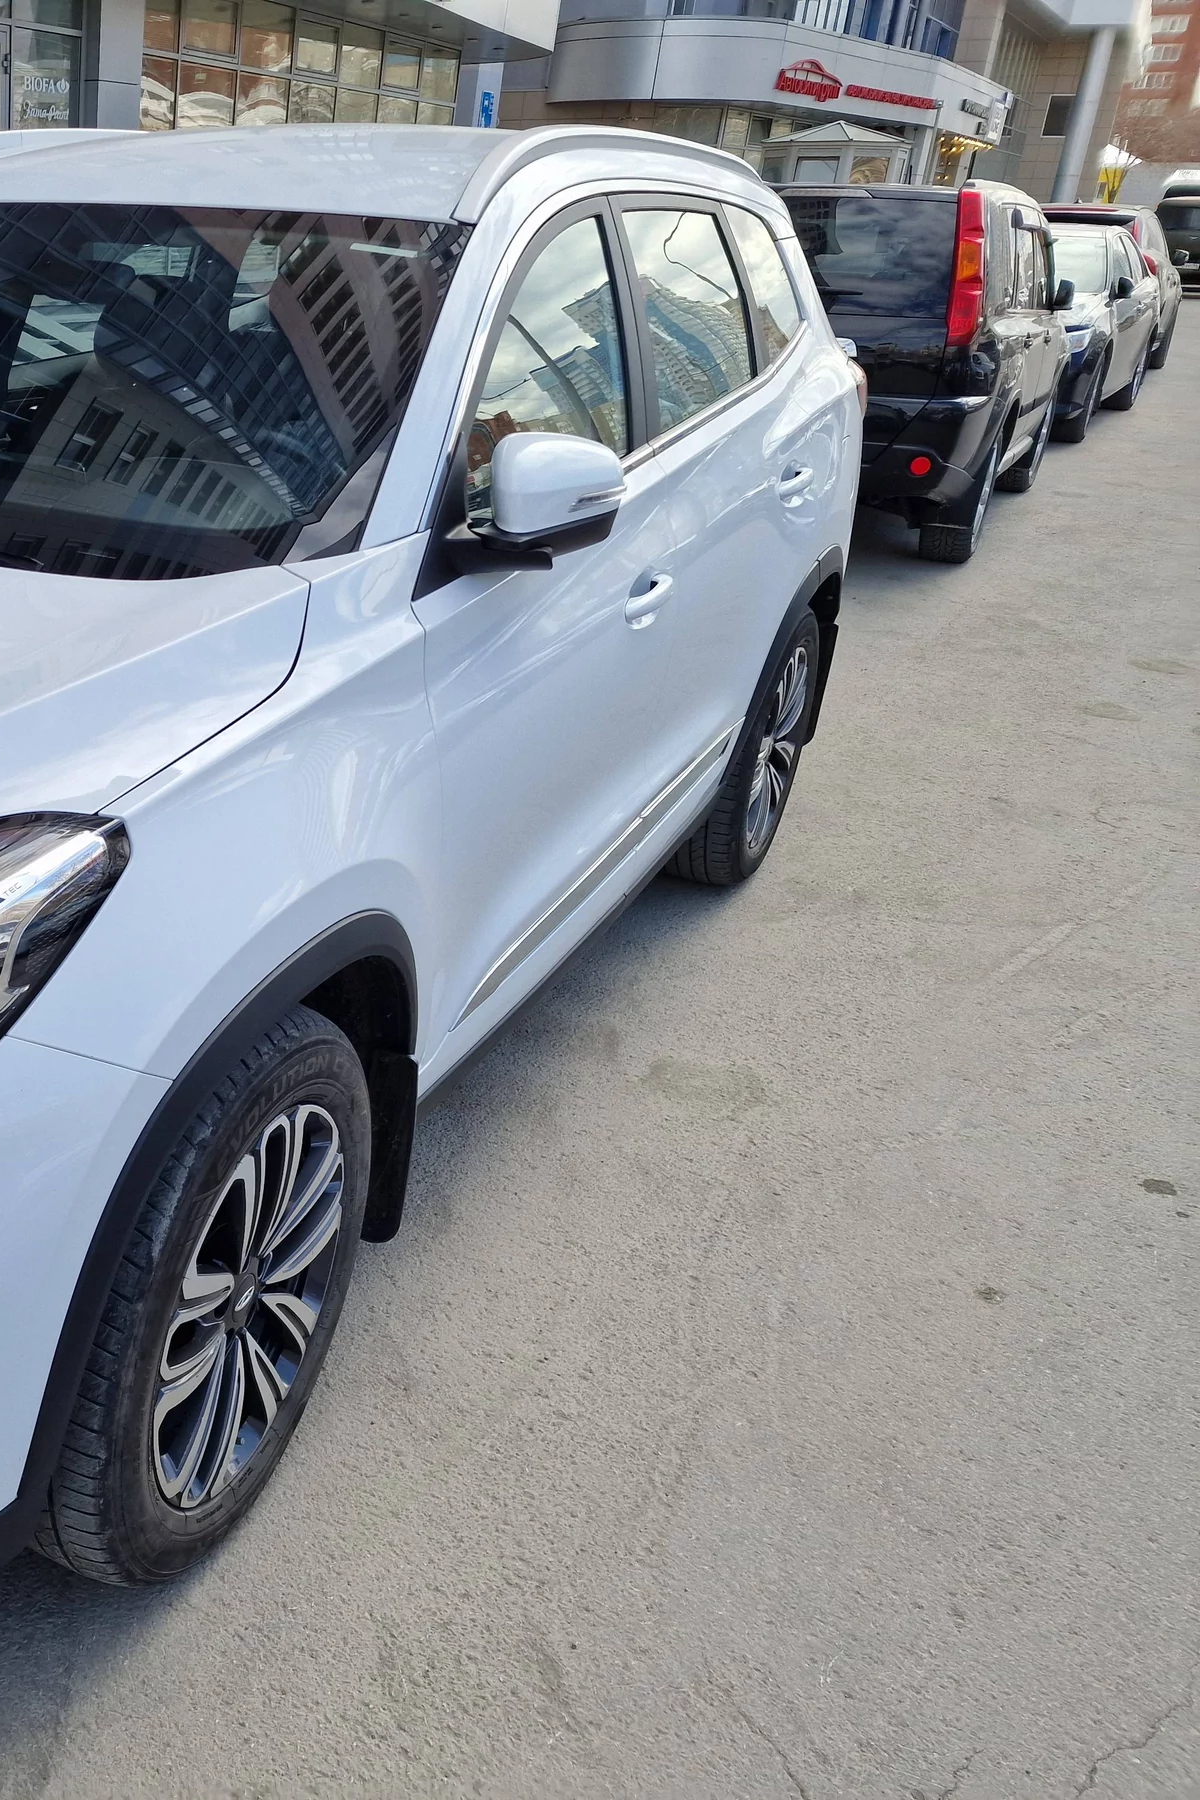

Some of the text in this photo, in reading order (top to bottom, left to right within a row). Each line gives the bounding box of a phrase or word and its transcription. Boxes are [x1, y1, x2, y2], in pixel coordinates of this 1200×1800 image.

[23, 75, 56, 94] BIOFA
[2, 881, 23, 897] TEC
[215, 1053, 330, 1182] EVOLUTION
